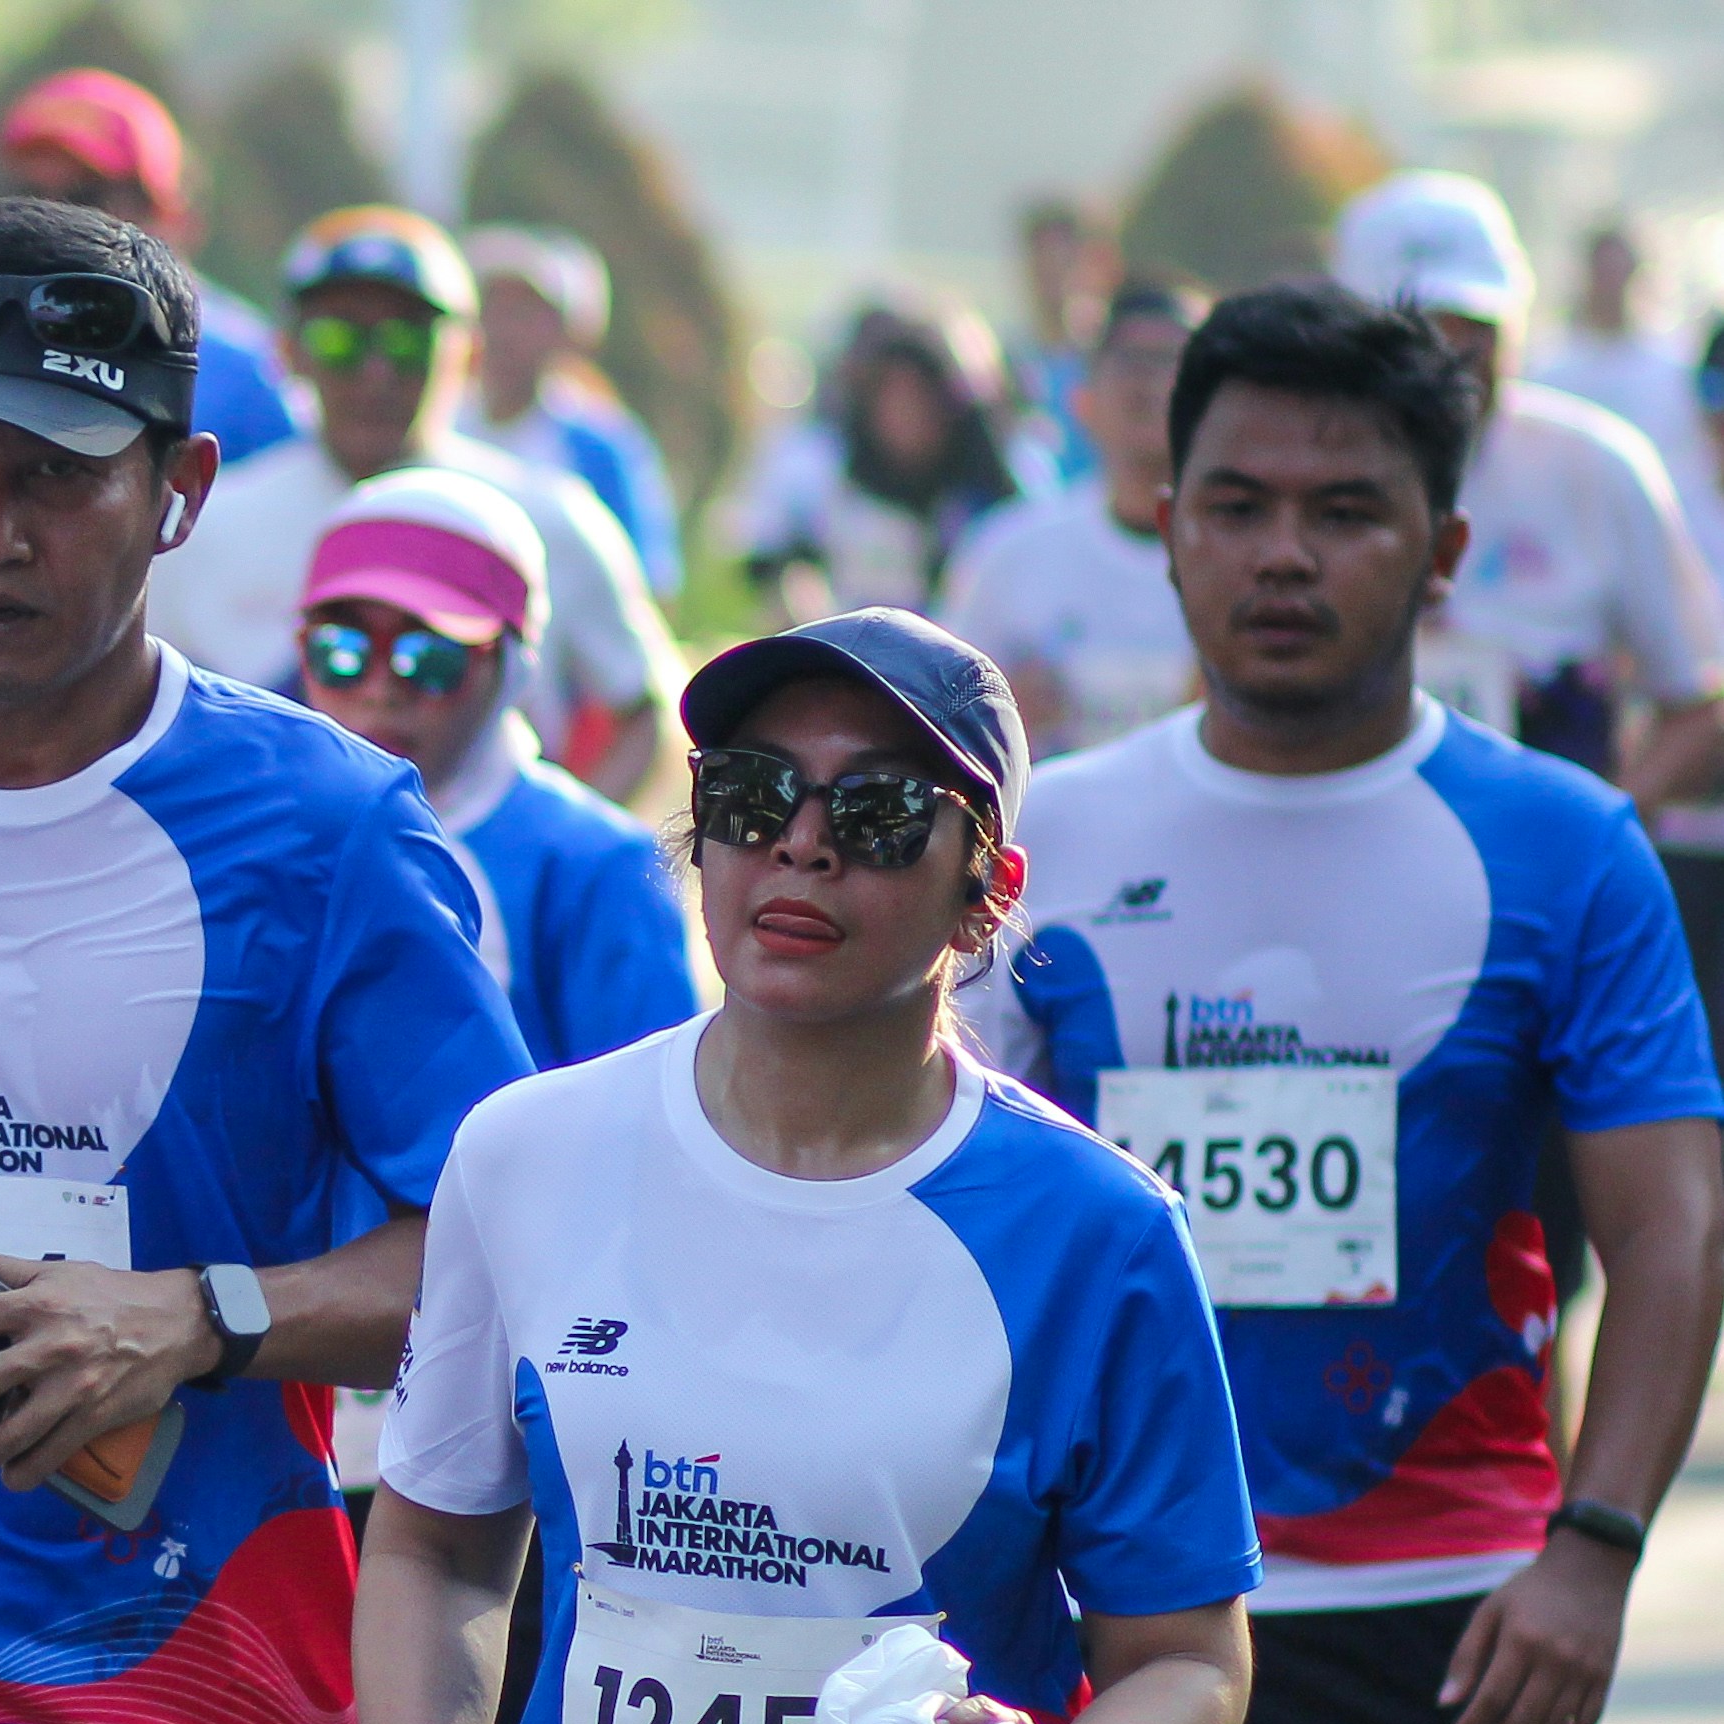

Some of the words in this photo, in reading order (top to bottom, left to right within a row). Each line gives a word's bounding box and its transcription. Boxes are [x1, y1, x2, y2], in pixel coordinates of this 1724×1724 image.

[42, 349, 125, 391] 2XU
[1114, 1134, 1361, 1213] 4530
[545, 1362, 568, 1373] new
[568, 1360, 629, 1377] balance
[636, 1490, 778, 1531] JAKARTA
[638, 1518, 891, 1573] INTERNATIONAL
[638, 1547, 807, 1588] MARATHON
